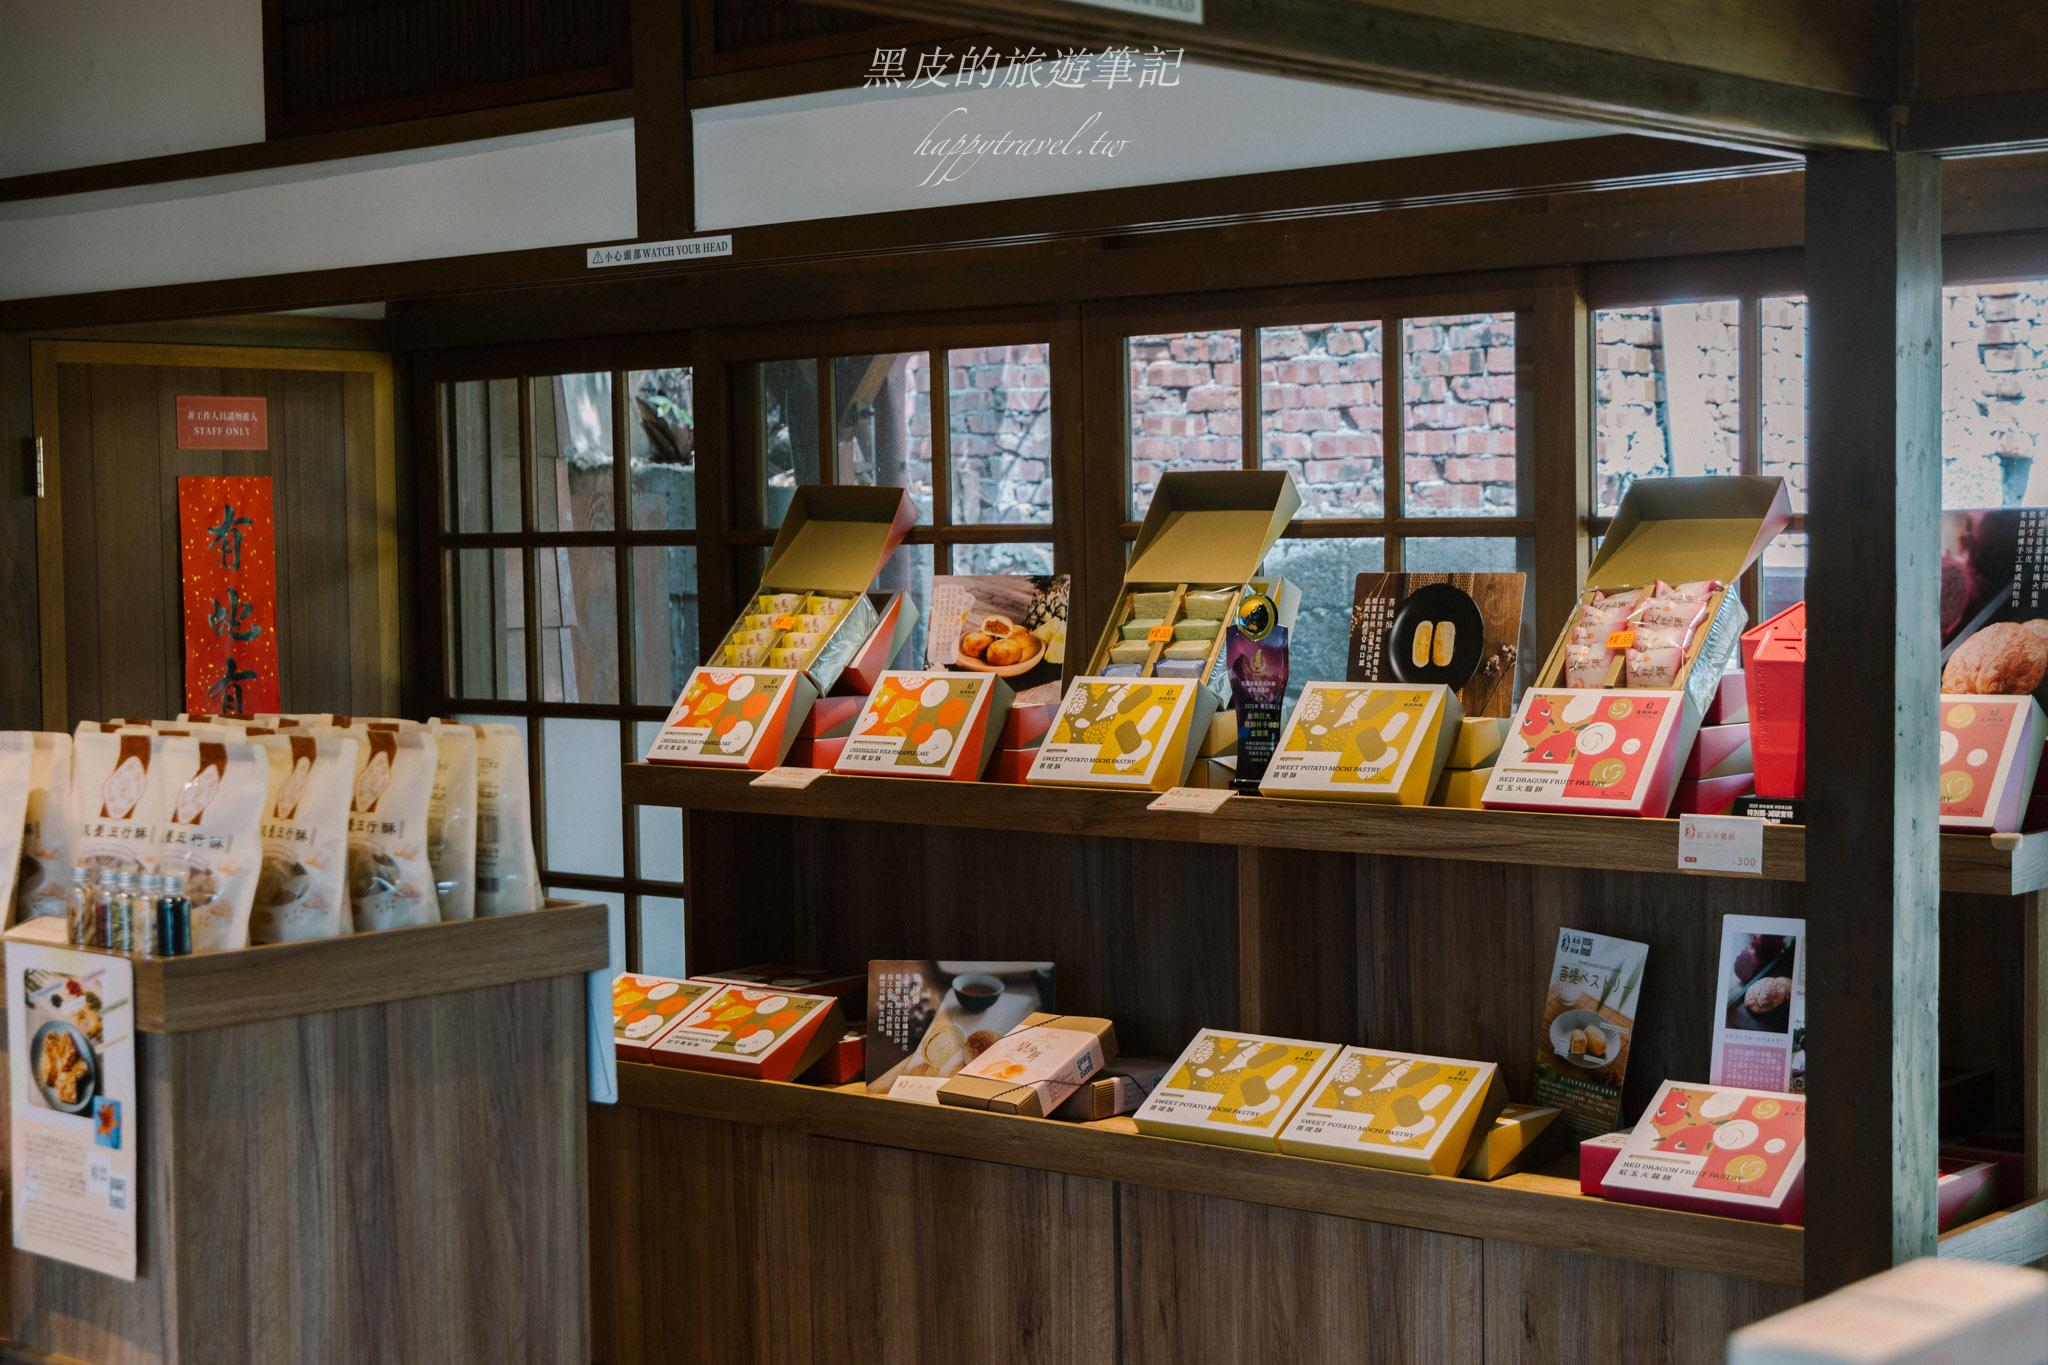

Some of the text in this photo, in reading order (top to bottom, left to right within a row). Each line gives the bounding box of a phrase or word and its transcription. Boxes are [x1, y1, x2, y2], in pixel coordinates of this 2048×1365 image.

[605, 241, 728, 263] 小心頭部 WATCH YOUR HEAD
[193, 426, 250, 436] STAFF ONLY
[1300, 764, 1327, 772] POTATO
[1328, 765, 1353, 773] MOCHI
[1353, 766, 1381, 774] PASTRY
[1516, 776, 1549, 785] DRAGON
[1549, 778, 1574, 786] FRUIT
[1575, 779, 1607, 787] PASTRY
[1154, 1098, 1260, 1117] SWEET POTATO MOCHI PASTRY
[1300, 1119, 1415, 1138] SWEET POTATO MOCHI PASTRY
[1623, 1161, 1744, 1182] RED DRAGON FRUIT PASTRY
